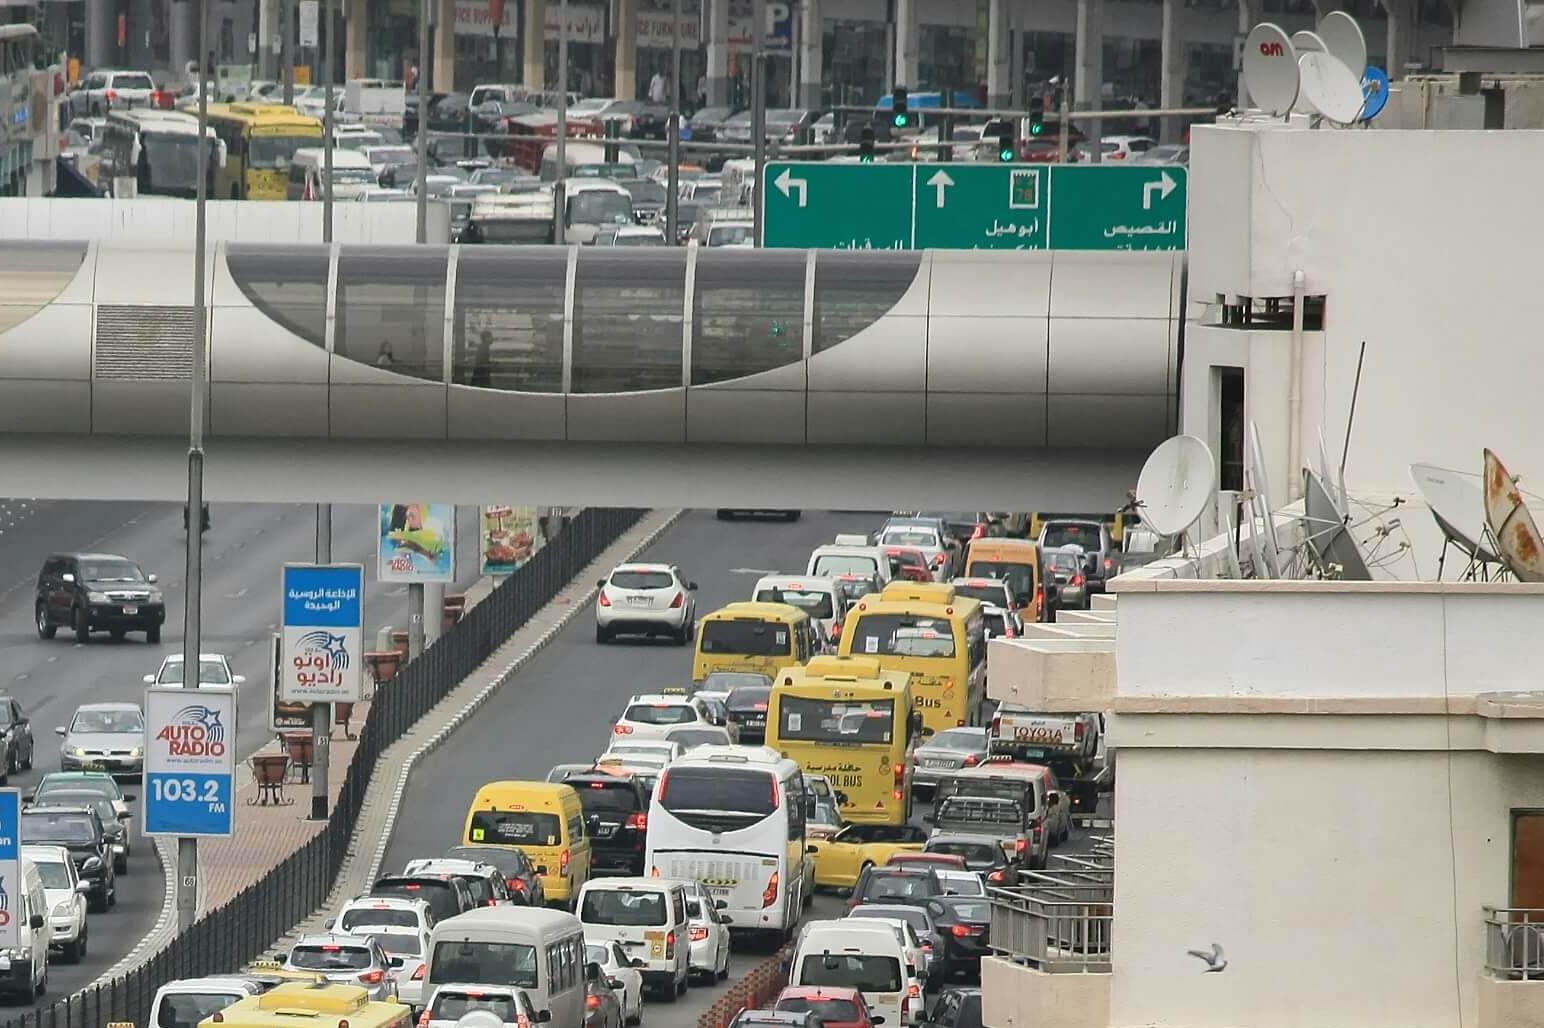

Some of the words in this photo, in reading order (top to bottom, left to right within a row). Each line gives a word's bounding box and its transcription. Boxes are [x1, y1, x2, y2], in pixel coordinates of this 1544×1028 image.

[1103, 220, 1177, 238] القصيص
[915, 696, 941, 708] Bus
[155, 725, 206, 741] AUTO
[1013, 727, 1063, 740] TOYOTA
[169, 740, 225, 757] RADIO
[843, 775, 863, 788] BUS
[152, 779, 219, 802] 103.2
[209, 803, 225, 813] FM
